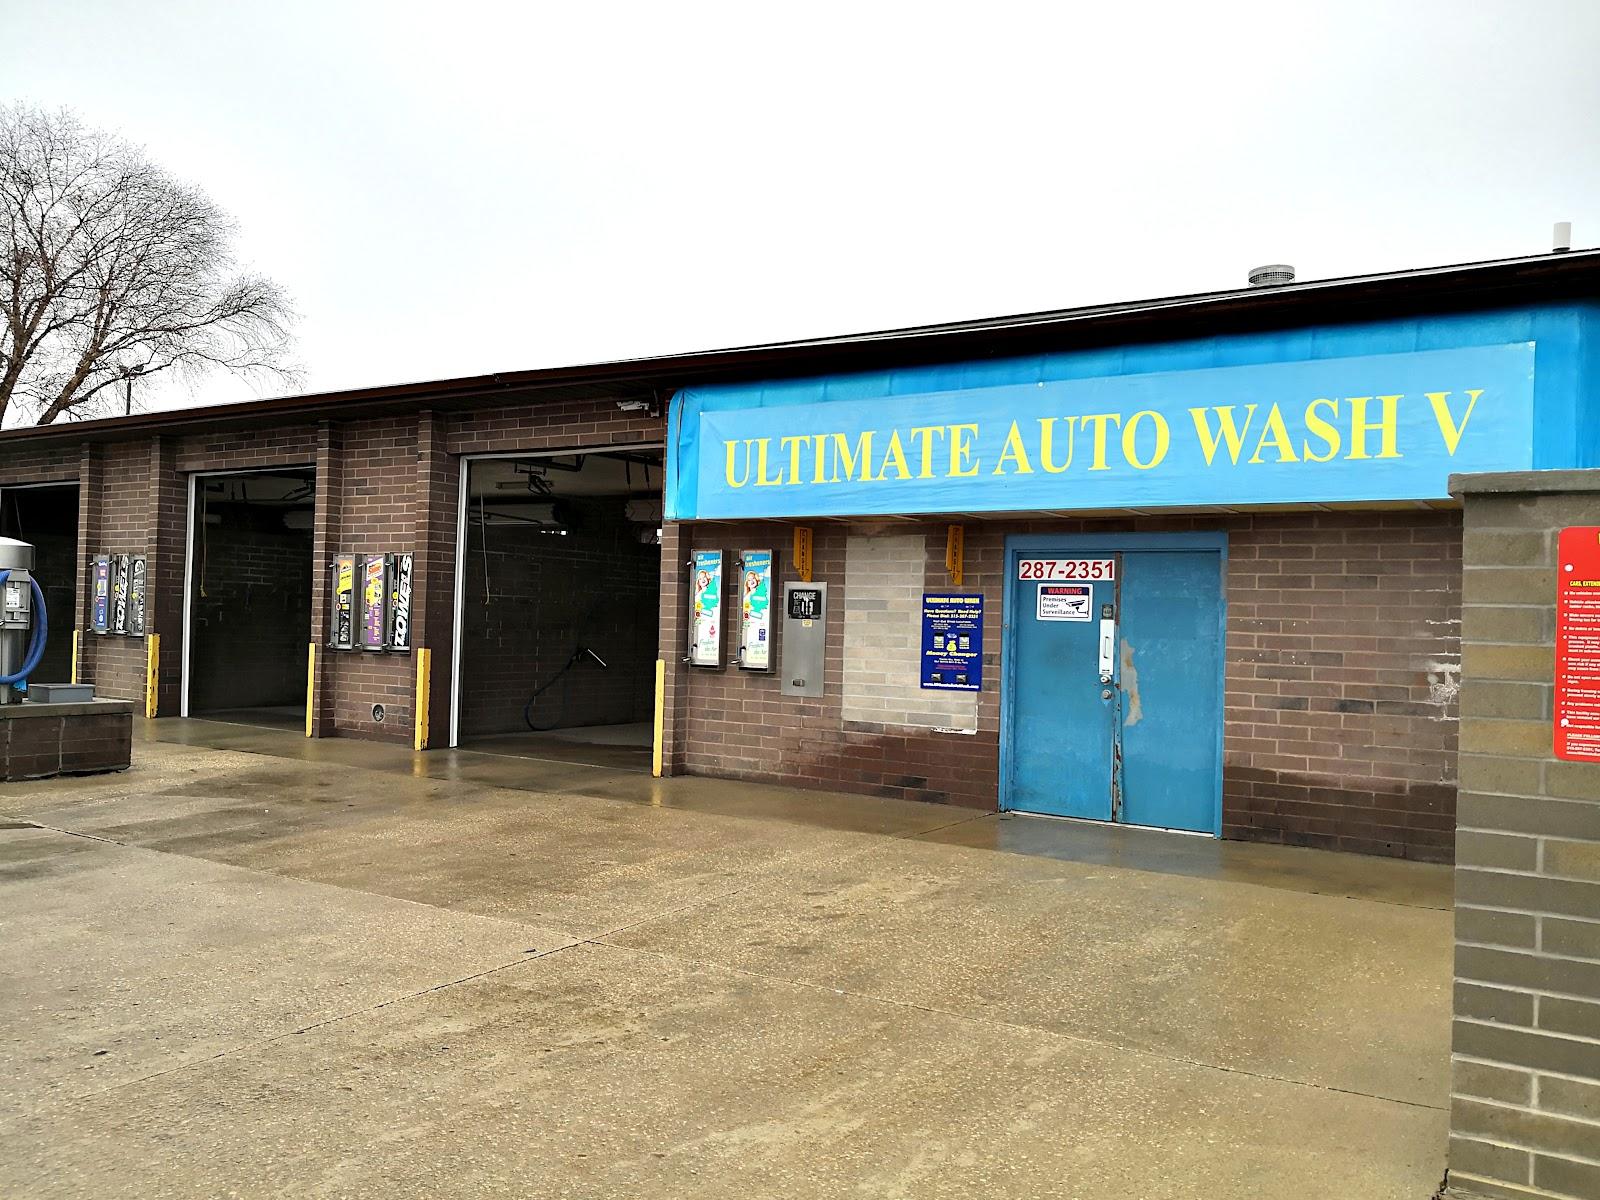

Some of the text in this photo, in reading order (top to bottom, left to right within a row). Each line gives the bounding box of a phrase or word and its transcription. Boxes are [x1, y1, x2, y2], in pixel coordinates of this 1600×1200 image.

[723, 388, 1484, 488] ULTIMATE AUTO WASH V
[1020, 561, 1113, 579] 287-2351
[793, 591, 816, 600] CHANGE
[1047, 587, 1083, 595] WARNING
[394, 555, 413, 647] TOWELS
